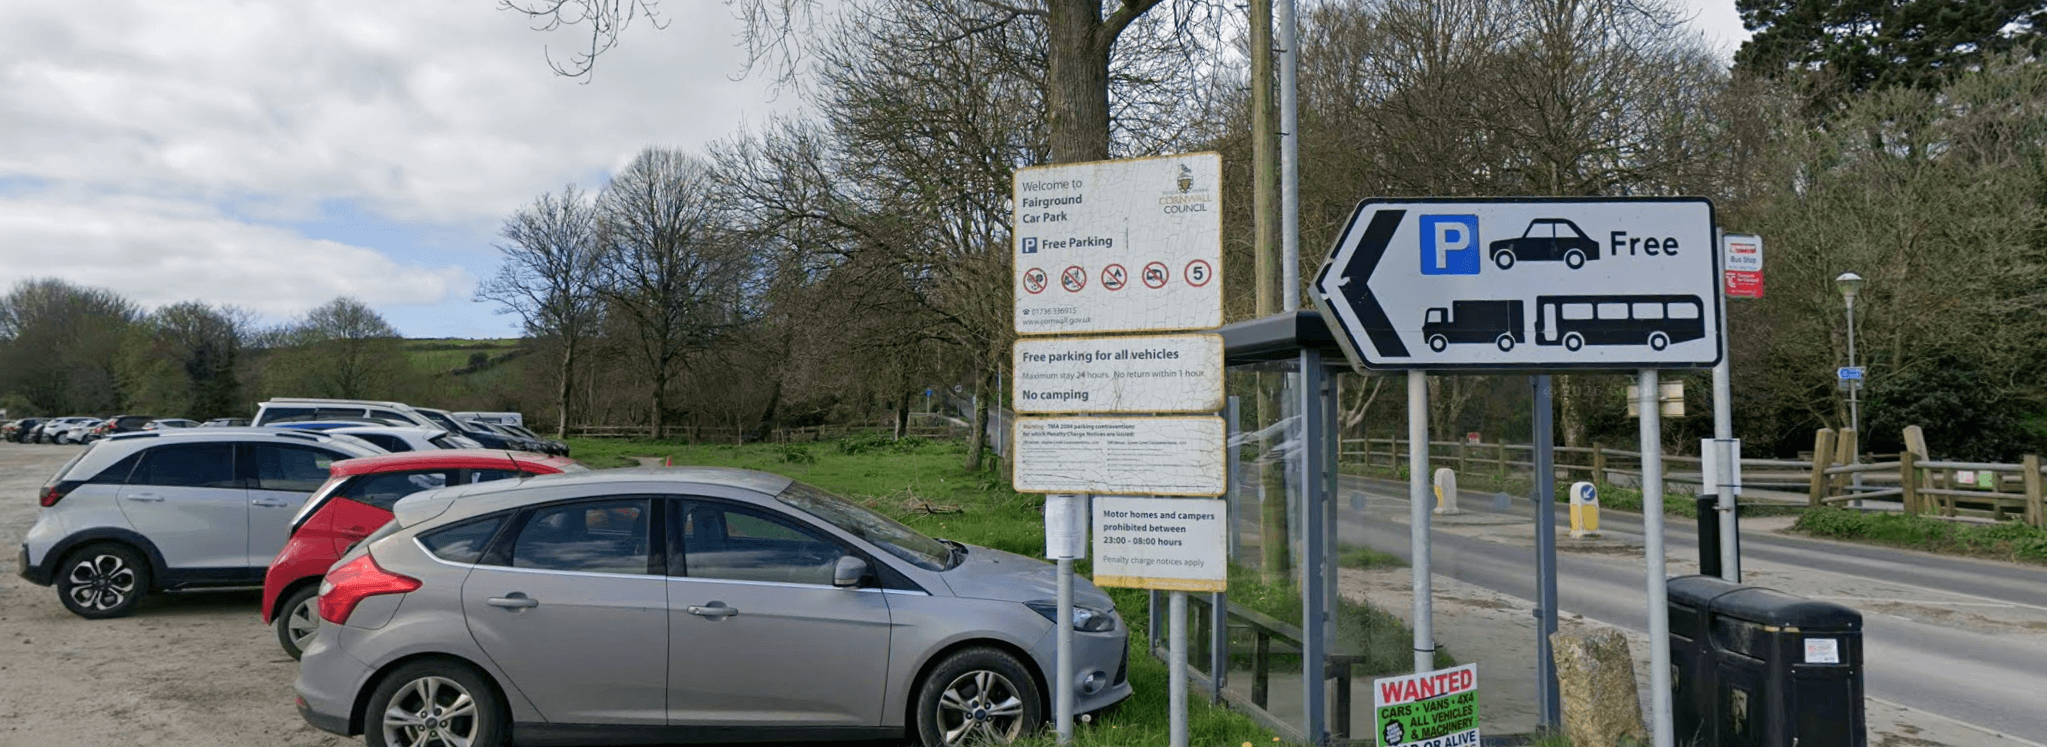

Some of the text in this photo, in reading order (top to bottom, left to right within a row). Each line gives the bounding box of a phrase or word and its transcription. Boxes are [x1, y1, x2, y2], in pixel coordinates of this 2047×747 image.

[1022, 180, 1082, 191] Welcome to
[1022, 194, 1082, 208] Fairground
[1159, 194, 1211, 204] CORNWALL
[1164, 203, 1207, 214] COUNCIL
[1022, 211, 1067, 223] Car Park
[1042, 239, 1066, 249] Free
[1069, 236, 1112, 248] Parking
[1435, 222, 1470, 269] P
[1610, 230, 1679, 256] Free
[1193, 266, 1203, 280] 5
[1022, 316, 1091, 325] www.cornwall.gov.uk
[1023, 348, 1179, 364] Free parking for all vehicles
[1060, 371, 1074, 380] stay
[1076, 371, 1085, 379] 24
[1114, 370, 1125, 378] No
[1022, 389, 1089, 402] No camping
[1103, 510, 1215, 521] Motor homes and campers
[1103, 523, 1186, 533] prohibited between
[1103, 536, 1126, 544] 23:00
[1133, 537, 1156, 545] 08:00
[1157, 538, 1182, 546] hours
[1103, 555, 1204, 568] Penalty charge notices apply
[1381, 669, 1473, 704] WANTED
[1381, 692, 1475, 719] CARS VANS 4X4
[1410, 704, 1474, 727] ALL VEHICLES
[1411, 729, 1418, 740] &
[1421, 716, 1474, 740] MACHINERY
[1445, 730, 1476, 747] ALIVE
